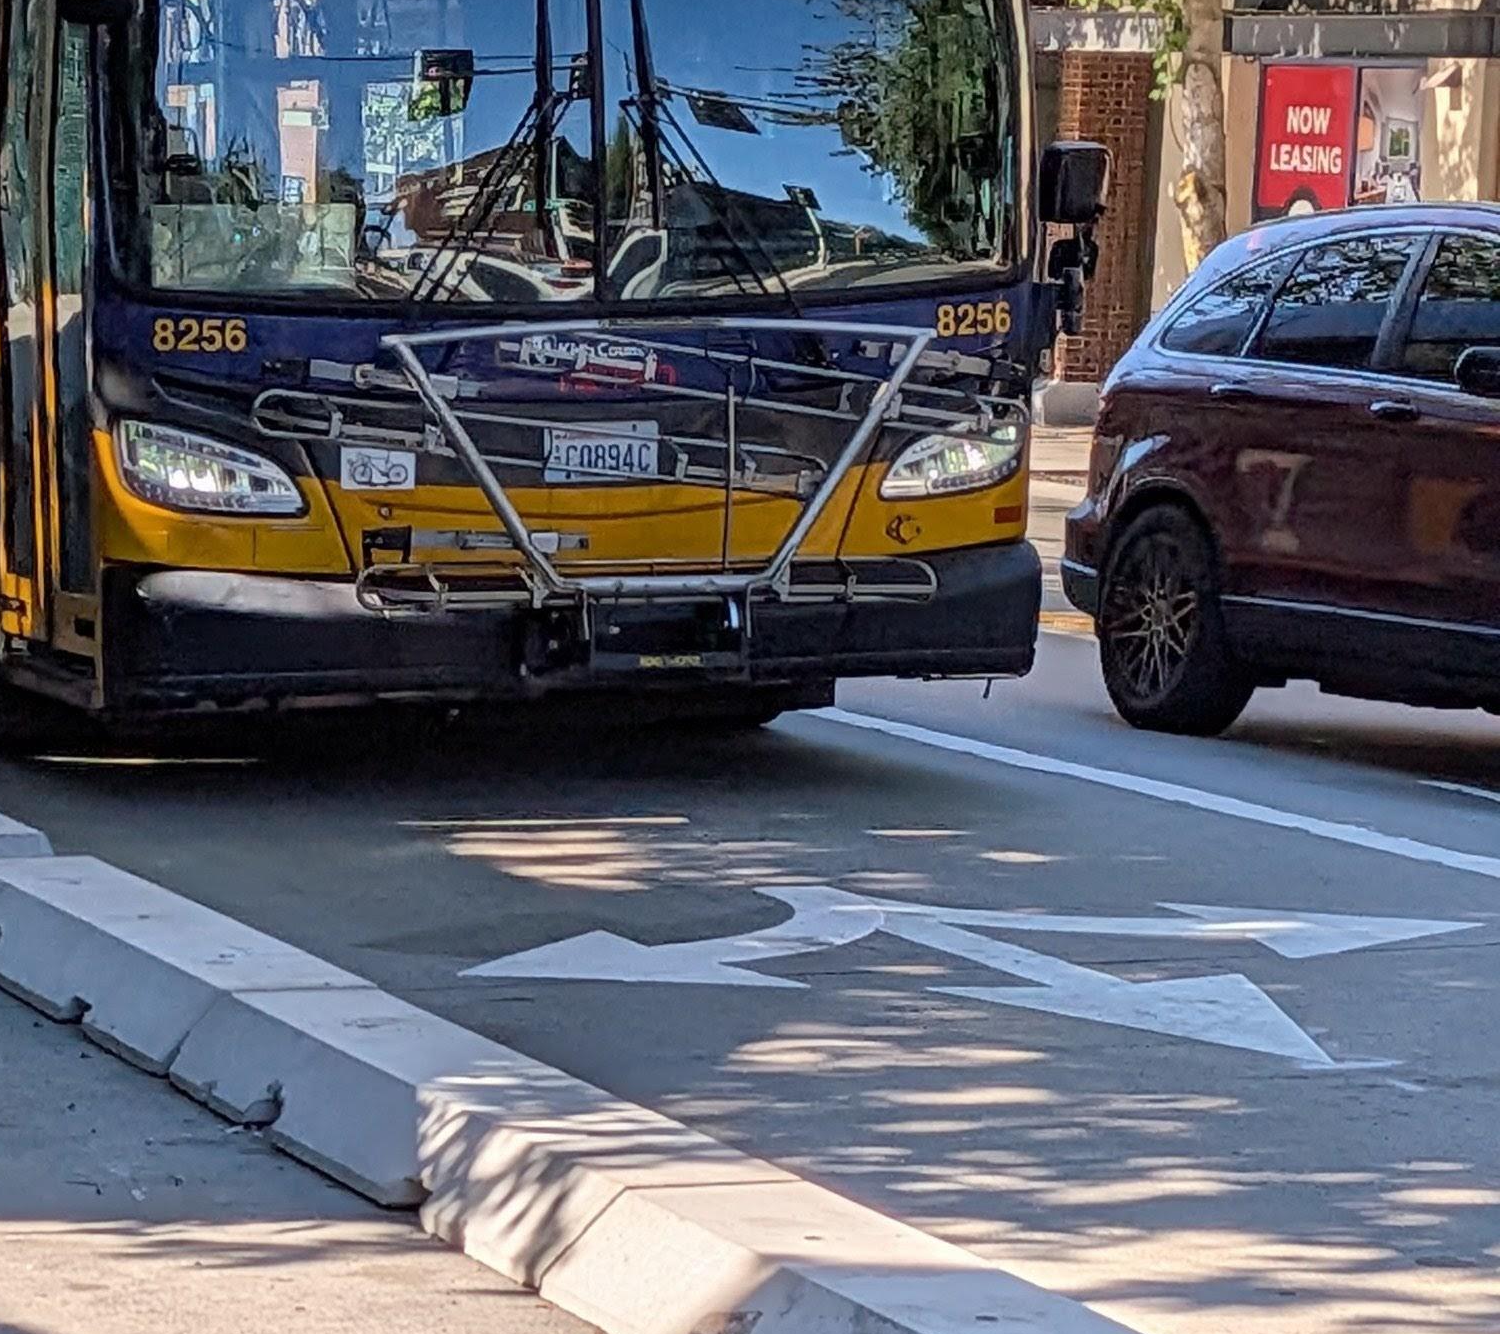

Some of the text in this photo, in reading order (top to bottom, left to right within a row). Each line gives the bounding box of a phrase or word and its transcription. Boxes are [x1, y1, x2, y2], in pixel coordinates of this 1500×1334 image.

[1286, 105, 1331, 135] NOW
[1269, 143, 1343, 174] LEASING
[154, 319, 247, 353] 8256
[936, 301, 1012, 339] 8256
